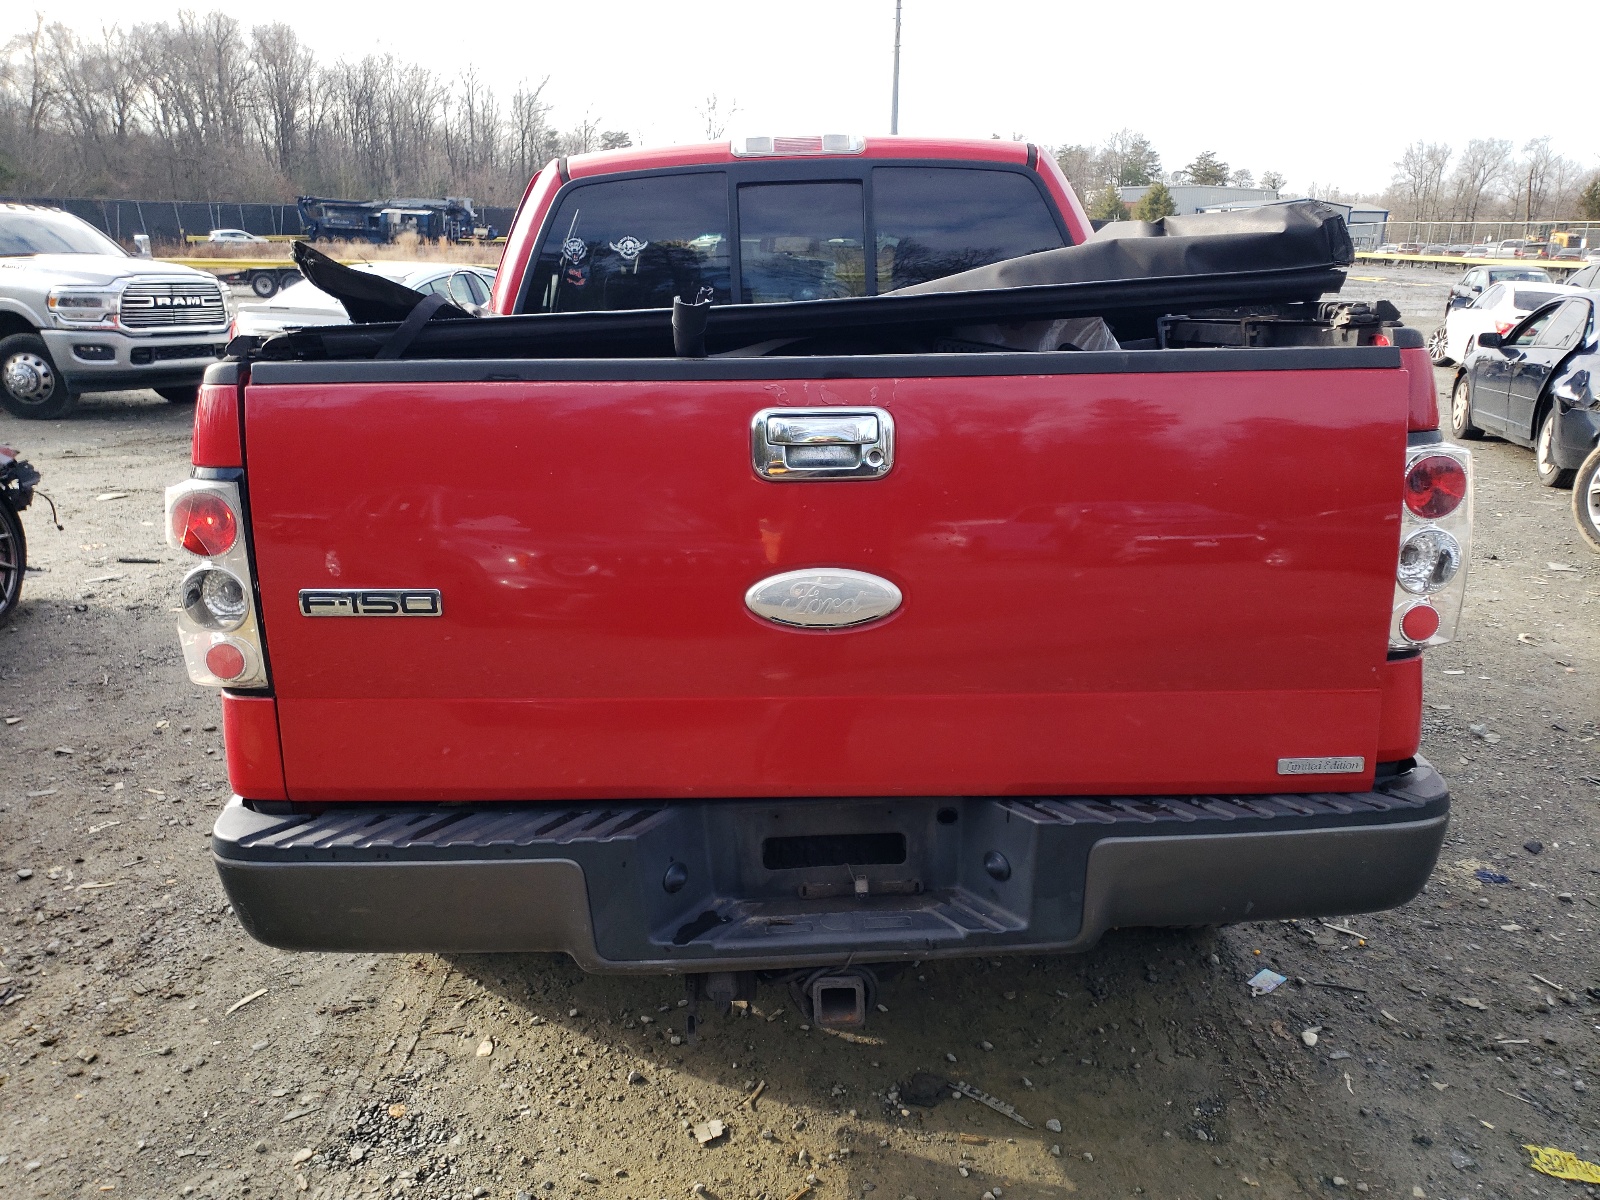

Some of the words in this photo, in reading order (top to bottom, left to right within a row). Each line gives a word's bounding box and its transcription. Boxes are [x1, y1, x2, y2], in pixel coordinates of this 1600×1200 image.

[156, 296, 201, 306] RAM
[302, 592, 438, 614] F-150
[781, 580, 867, 615] Ford
[1286, 761, 1322, 772] Limited
[1323, 760, 1359, 771] Edition
